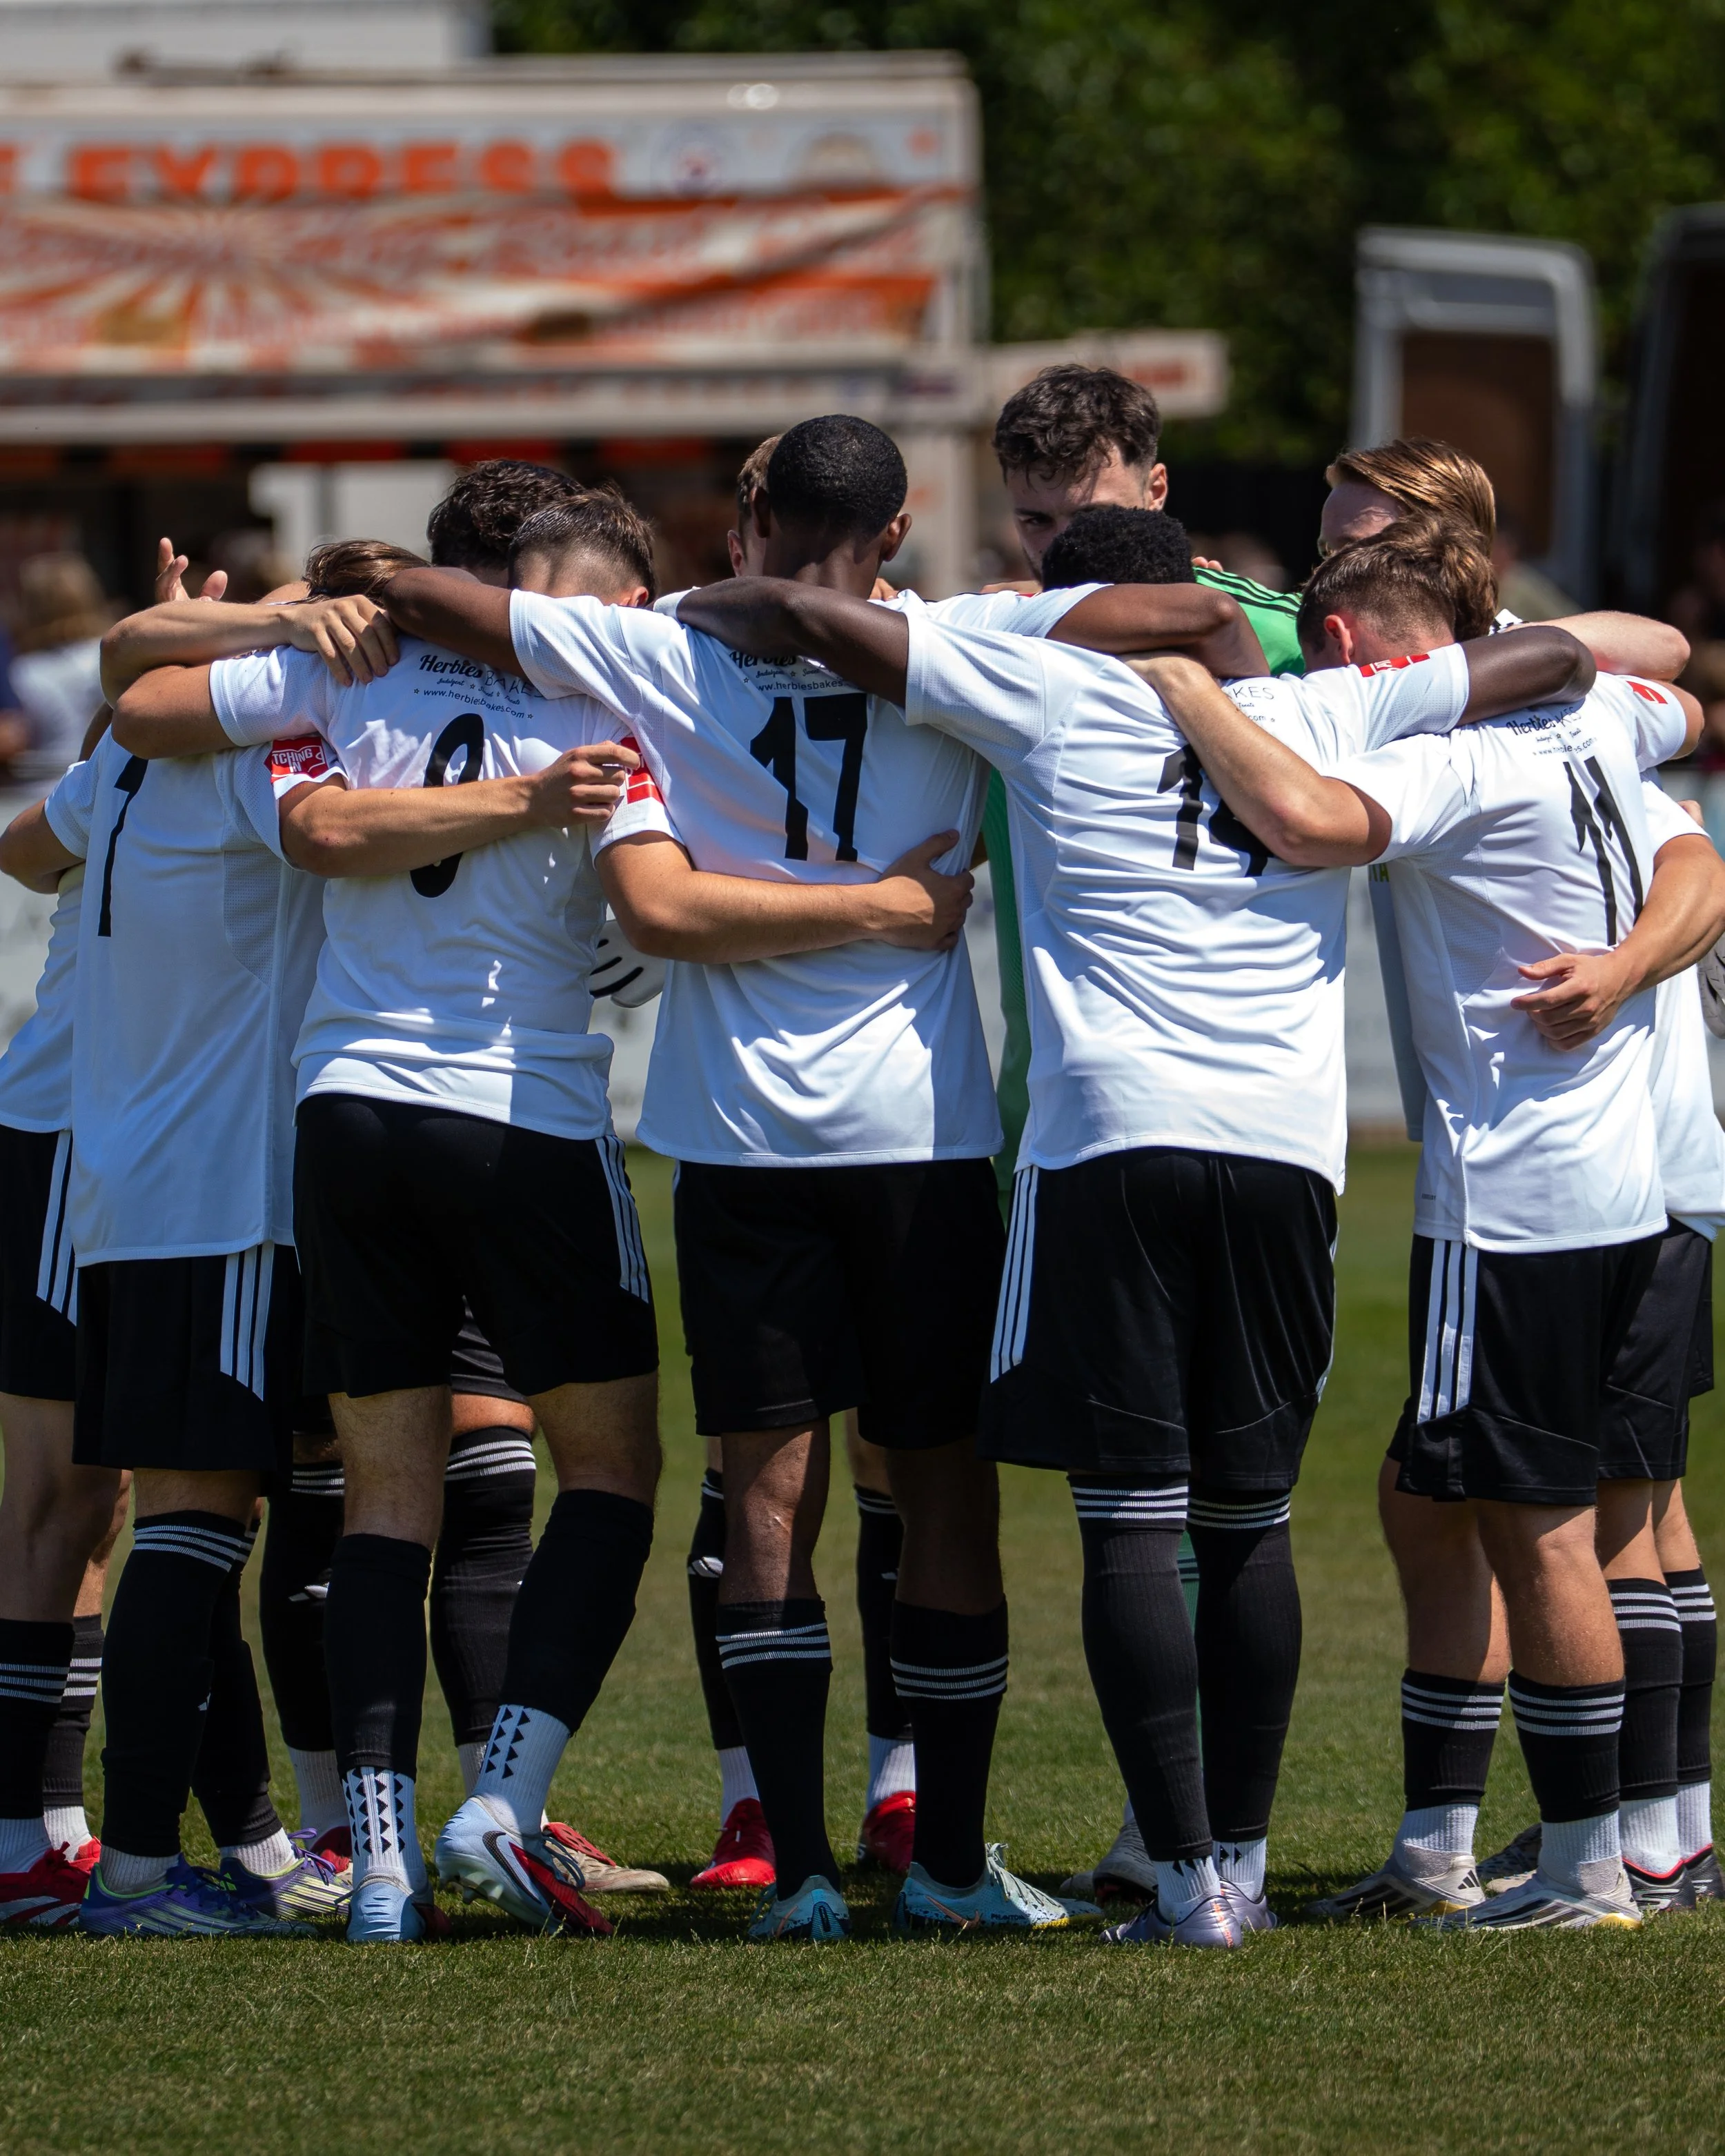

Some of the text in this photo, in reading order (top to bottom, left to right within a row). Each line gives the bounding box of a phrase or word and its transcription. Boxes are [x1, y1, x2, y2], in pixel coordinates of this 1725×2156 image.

[420, 655, 544, 698] Herbies BAKE
[757, 680, 845, 691] ww.herbiesbakes.
[1232, 686, 1274, 700] KES
[272, 748, 313, 765] TCHING
[750, 693, 867, 862] 17
[1562, 755, 1644, 947] 11
